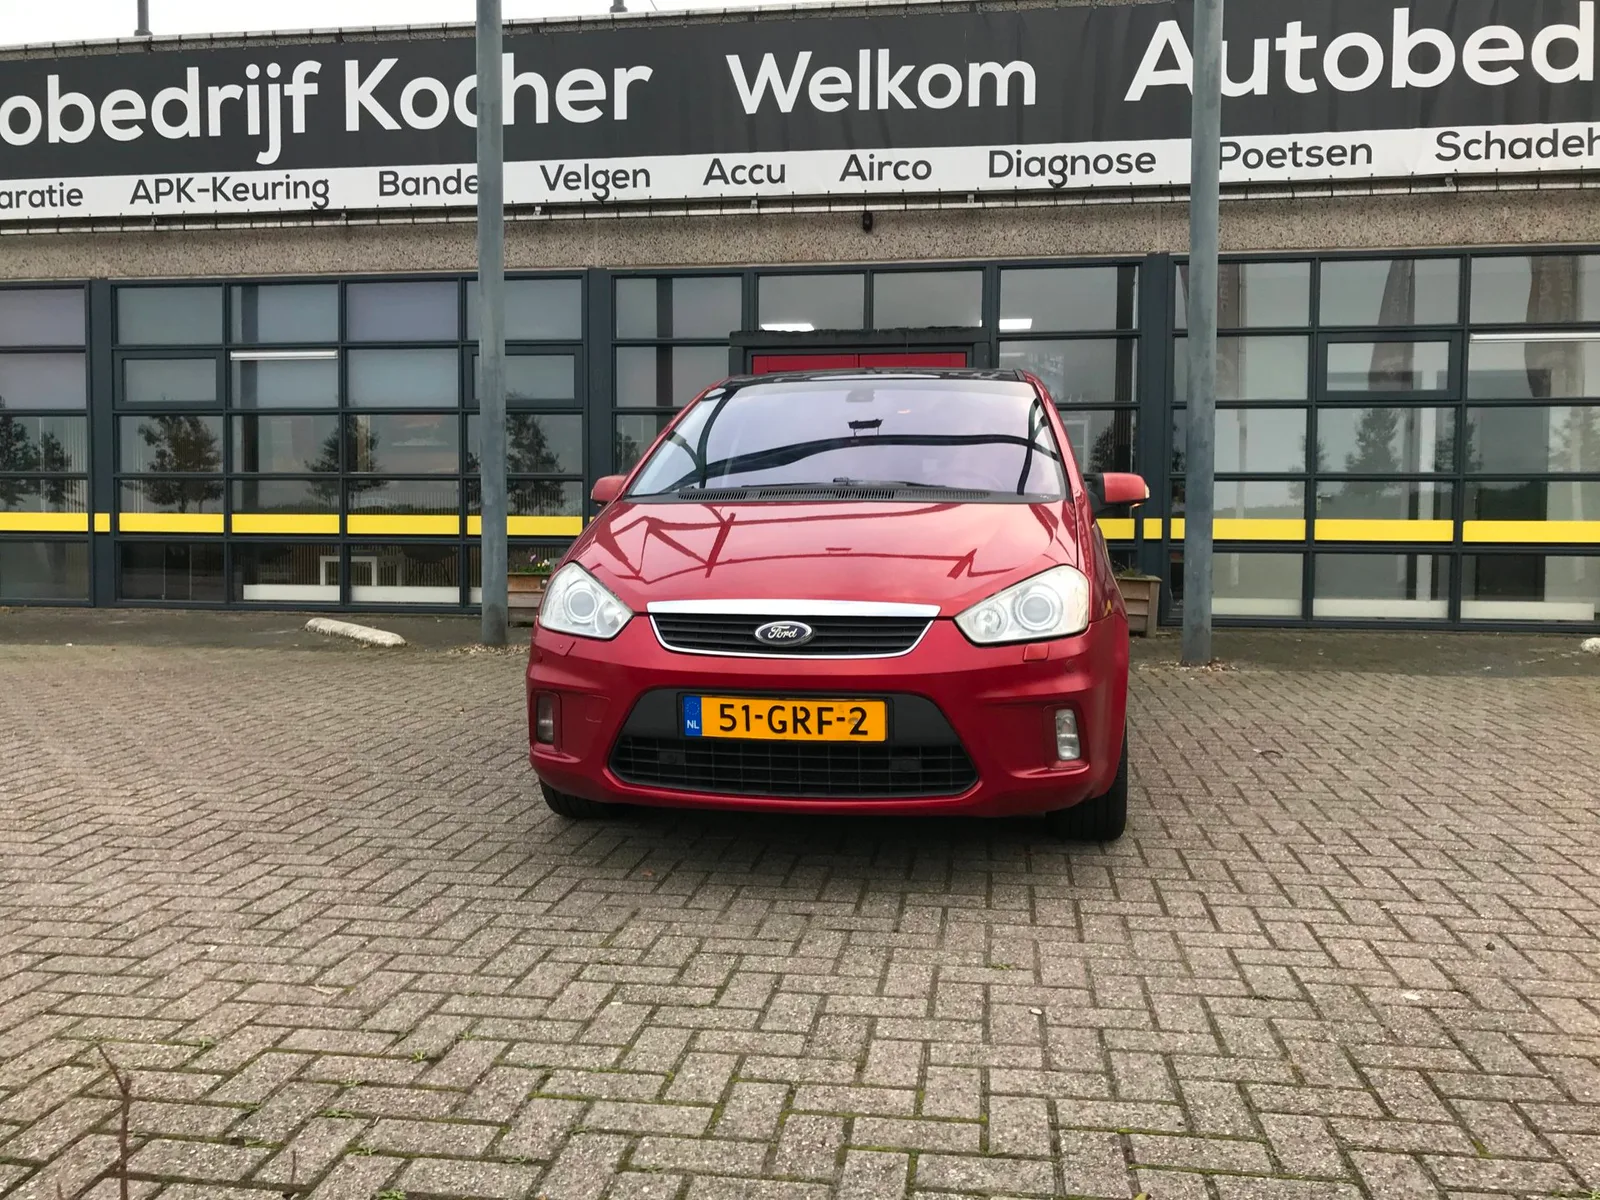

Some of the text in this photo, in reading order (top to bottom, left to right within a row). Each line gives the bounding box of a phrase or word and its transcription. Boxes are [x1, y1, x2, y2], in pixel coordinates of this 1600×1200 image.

[0, 1, 1594, 165] obedrijf Kocher Welkom Autobed
[0, 127, 1600, 210] aratie APK-Keuring Bande Velgen Accu Airco Diagnose Poetsen Schadeh
[767, 625, 798, 639] Ford
[686, 719, 700, 729] NL
[719, 703, 868, 736] 51-GRF-2
